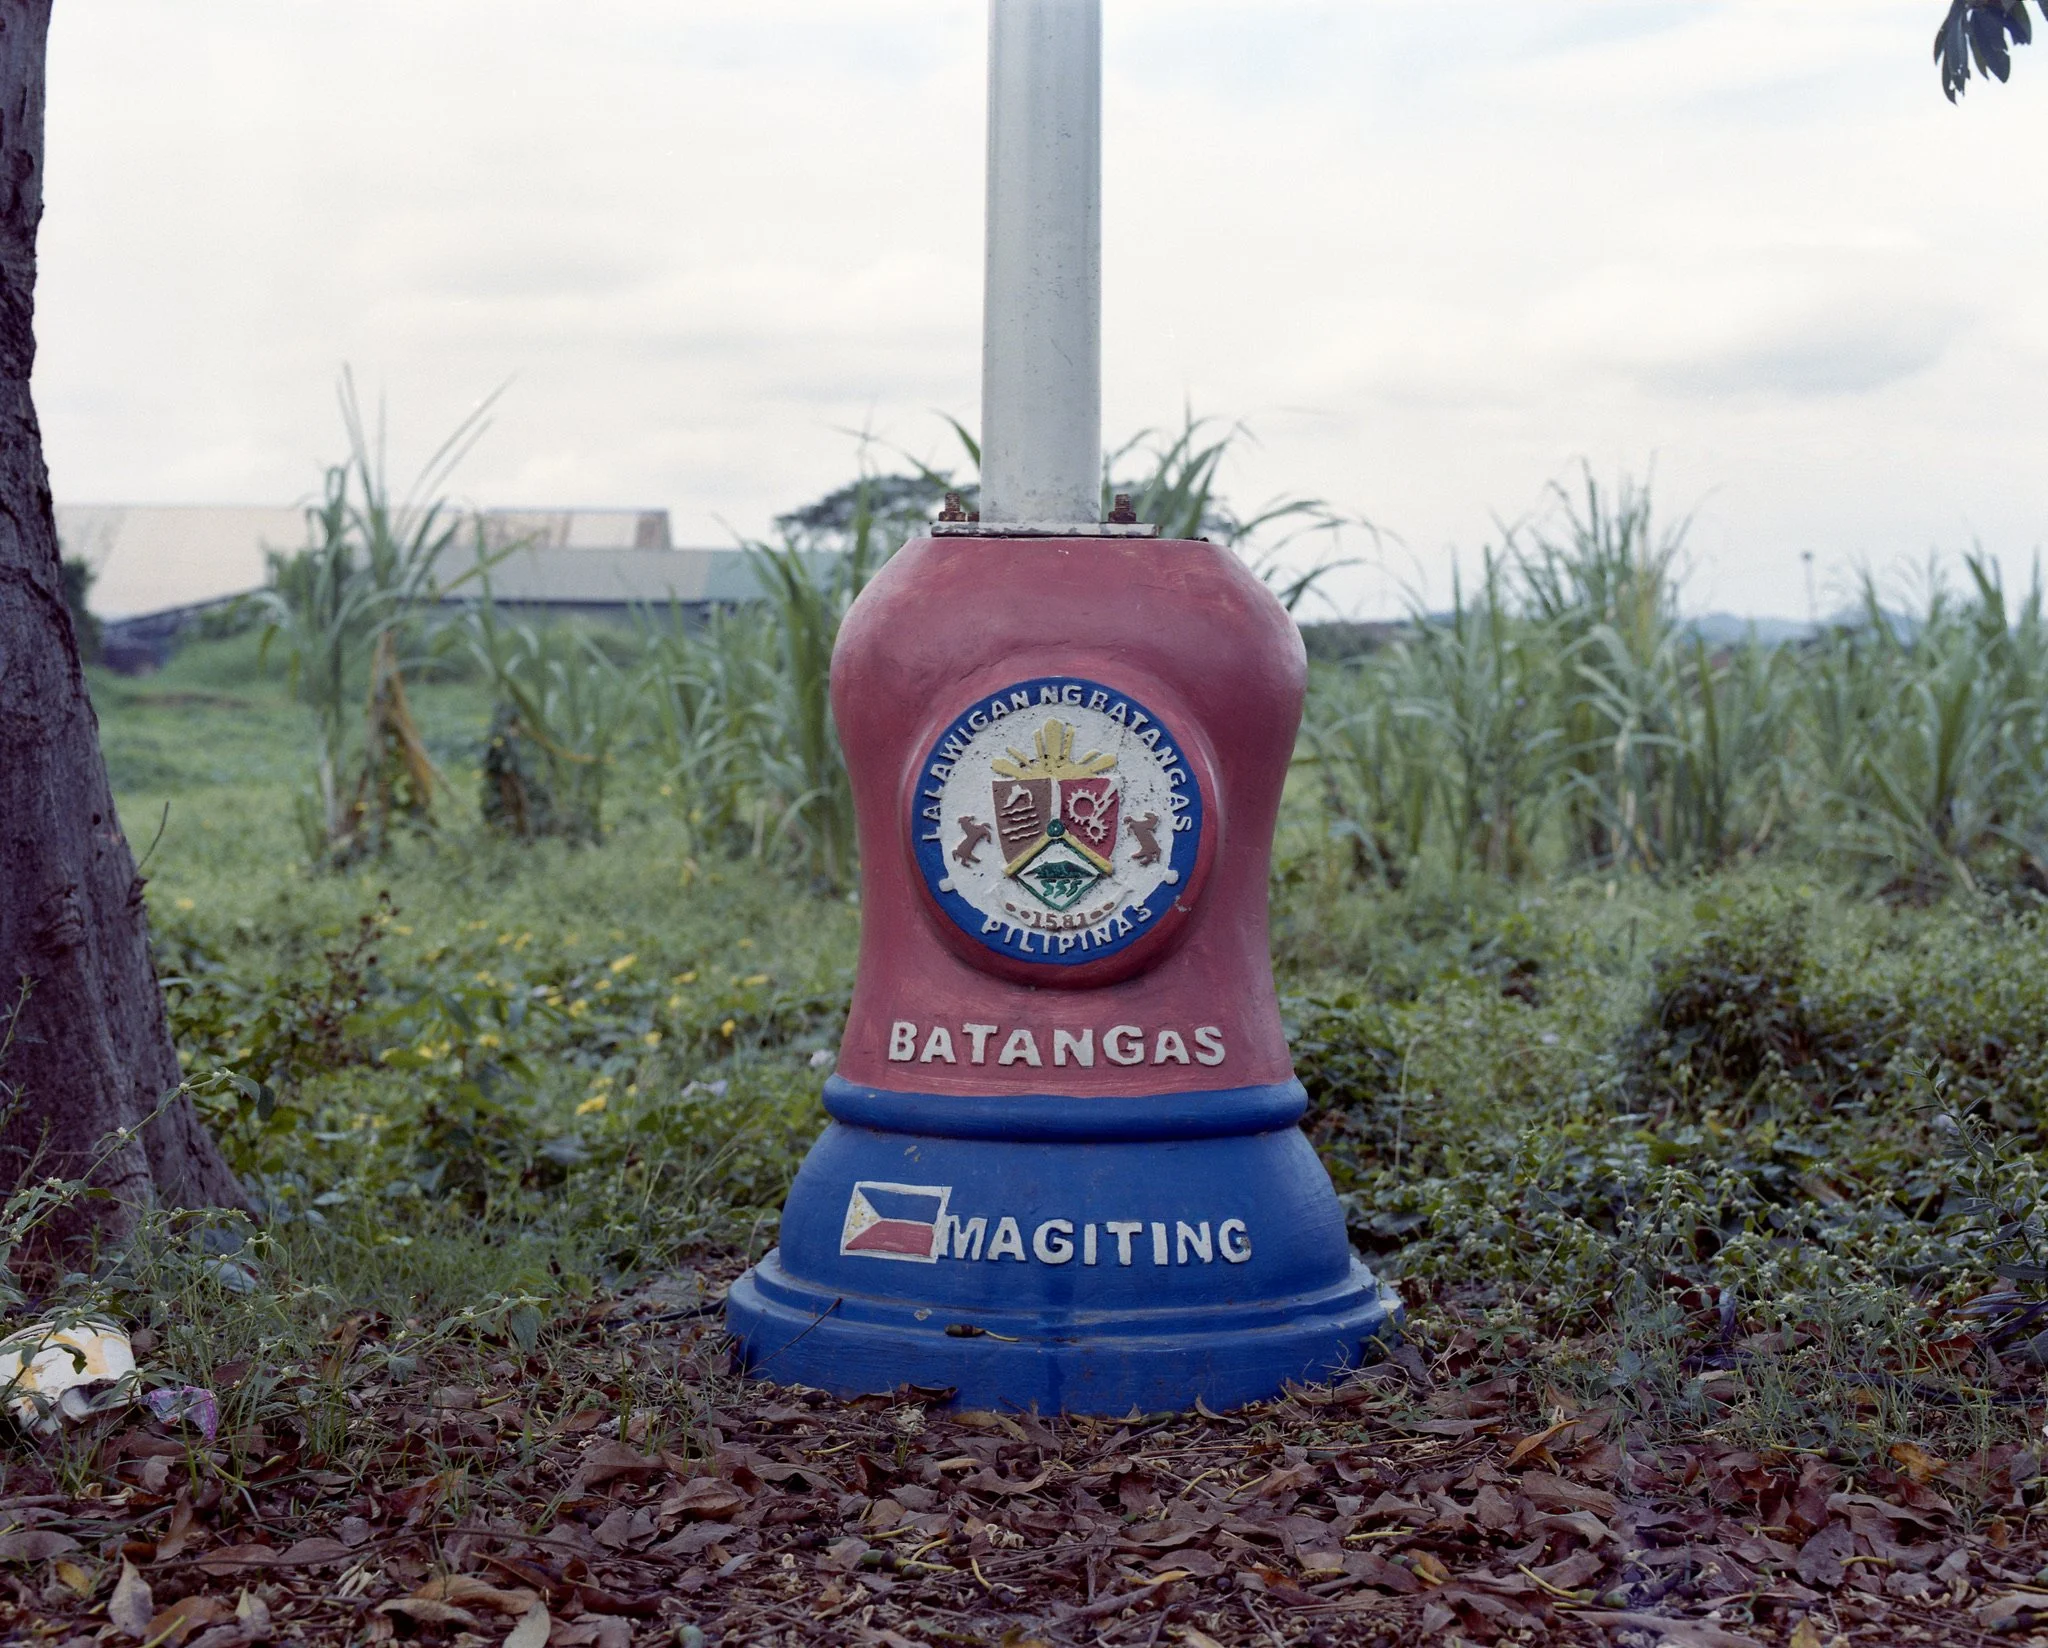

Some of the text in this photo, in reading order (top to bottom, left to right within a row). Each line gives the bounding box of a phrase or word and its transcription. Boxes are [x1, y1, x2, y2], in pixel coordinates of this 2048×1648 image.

[922, 685, 1192, 842] LALAWIGAN NG BATANGAS
[981, 903, 1153, 954] PILIPINAS
[1031, 911, 1088, 929] 1581
[888, 1021, 1226, 1067] BATANGAS
[943, 1214, 1252, 1266] MAGITING
